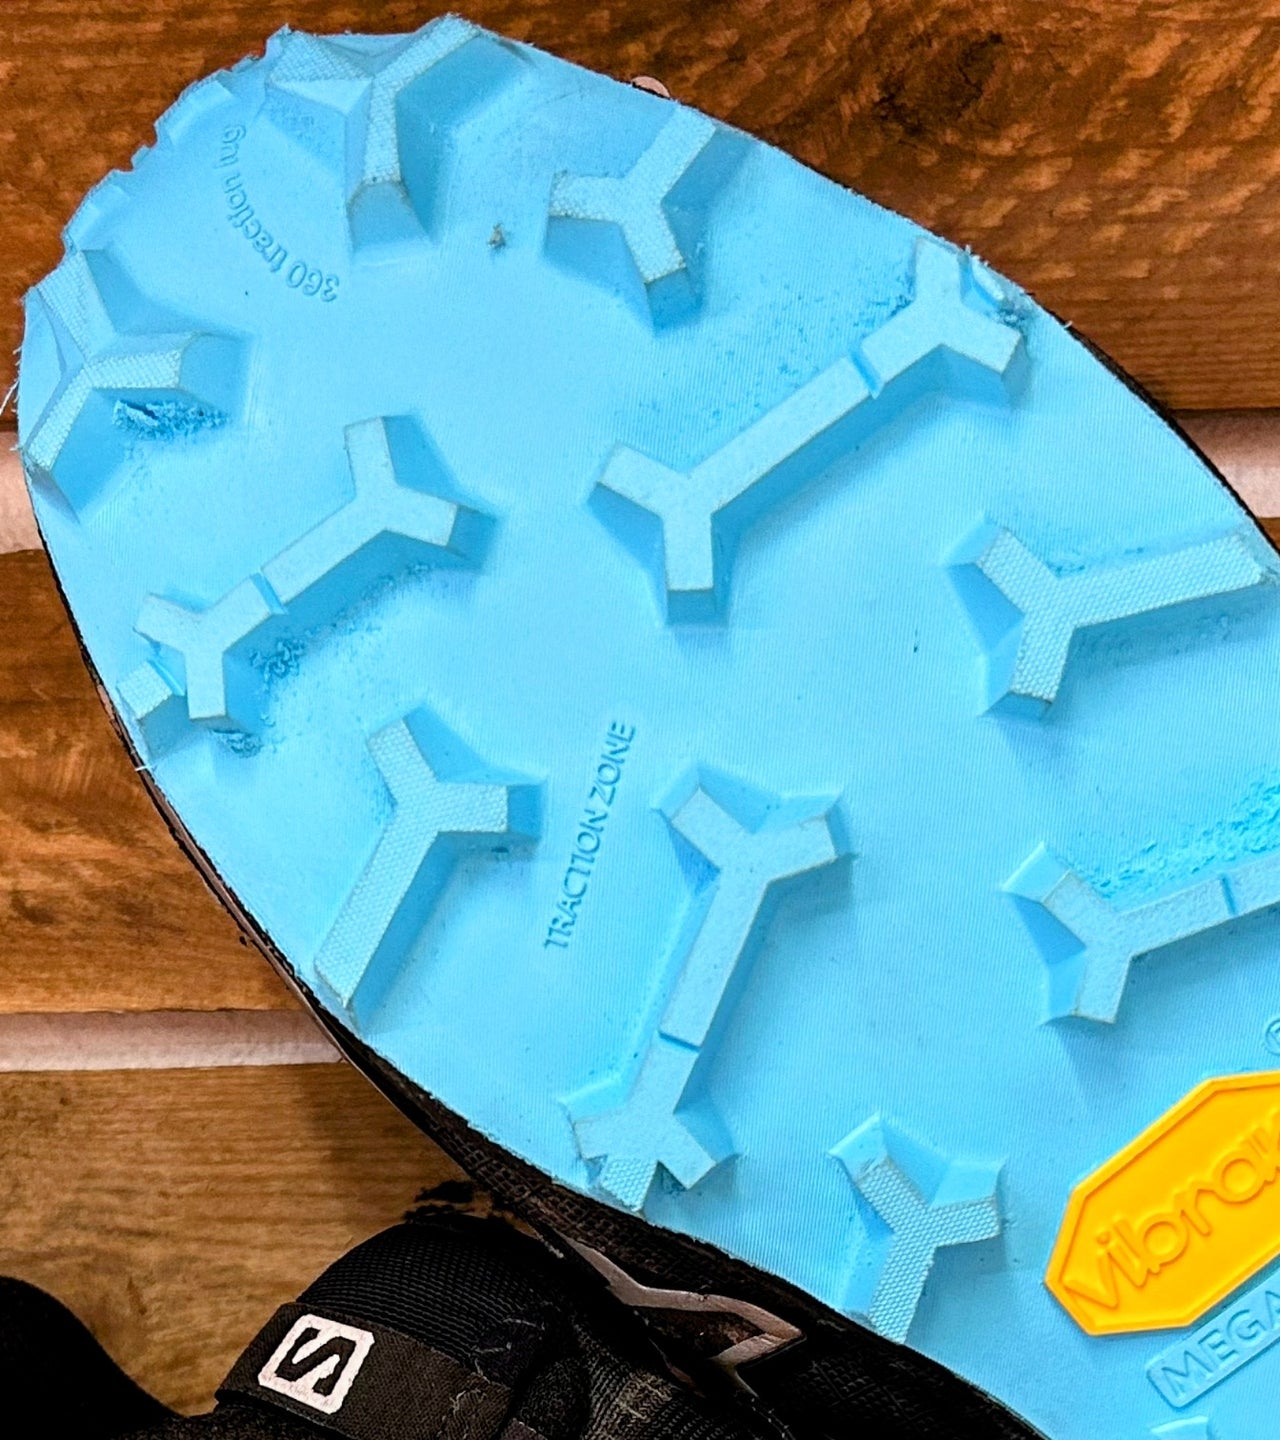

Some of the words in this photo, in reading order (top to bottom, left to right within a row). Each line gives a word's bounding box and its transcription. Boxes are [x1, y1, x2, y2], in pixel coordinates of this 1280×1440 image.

[224, 172, 288, 273] traction
[285, 260, 340, 303] 360
[542, 808, 609, 950] TRACTION
[587, 719, 637, 807] ZONE
